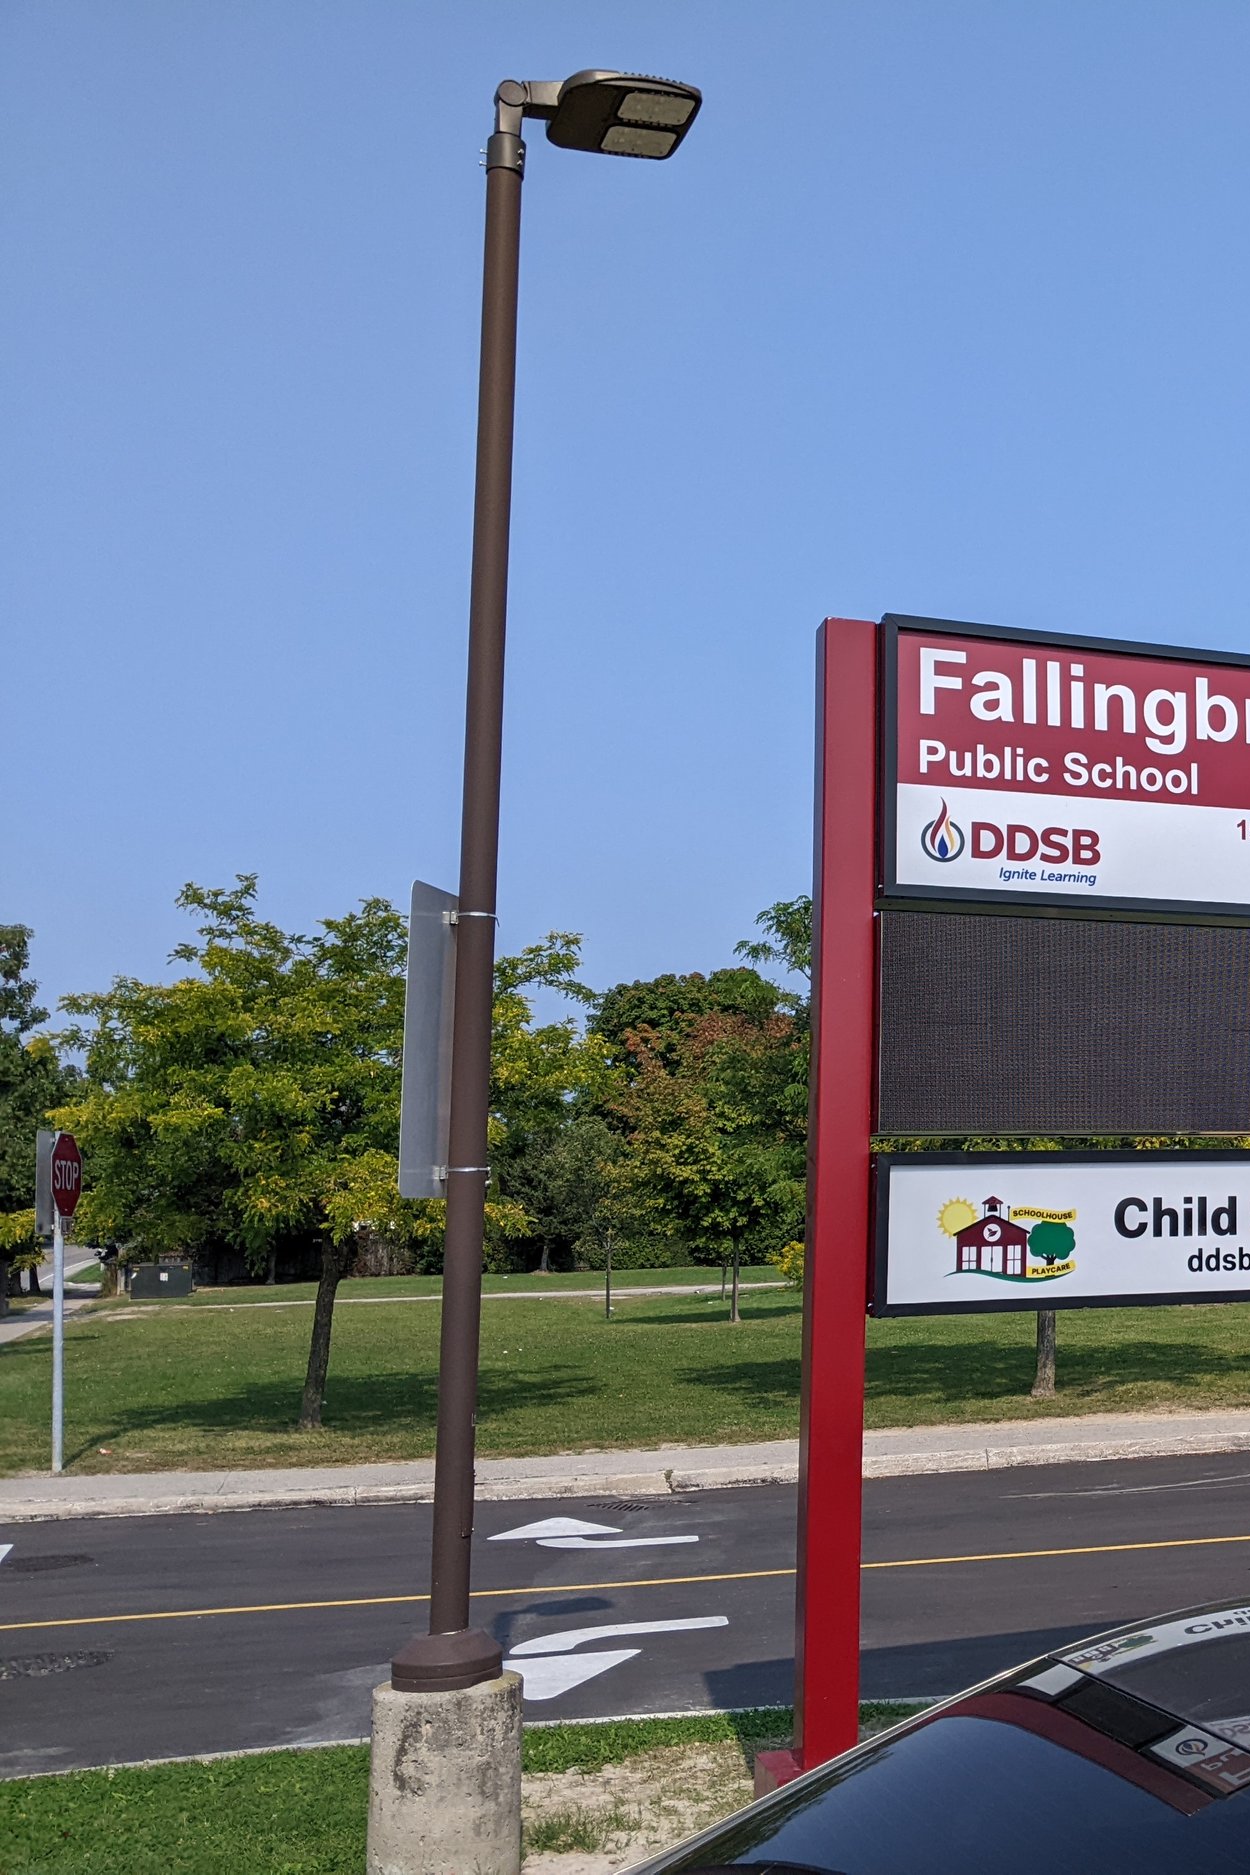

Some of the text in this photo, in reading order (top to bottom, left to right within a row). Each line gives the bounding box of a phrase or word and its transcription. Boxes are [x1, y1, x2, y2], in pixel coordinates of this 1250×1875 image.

[919, 739, 1199, 795] Public School
[971, 821, 1101, 866] DDSB
[999, 867, 1097, 886] Ignite Learning
[54, 1160, 79, 1190] STOP
[1012, 1209, 1073, 1220] SCHOOLHOUSE
[1114, 1196, 1238, 1238] Child
[1031, 1262, 1071, 1275] PLAYCARE
